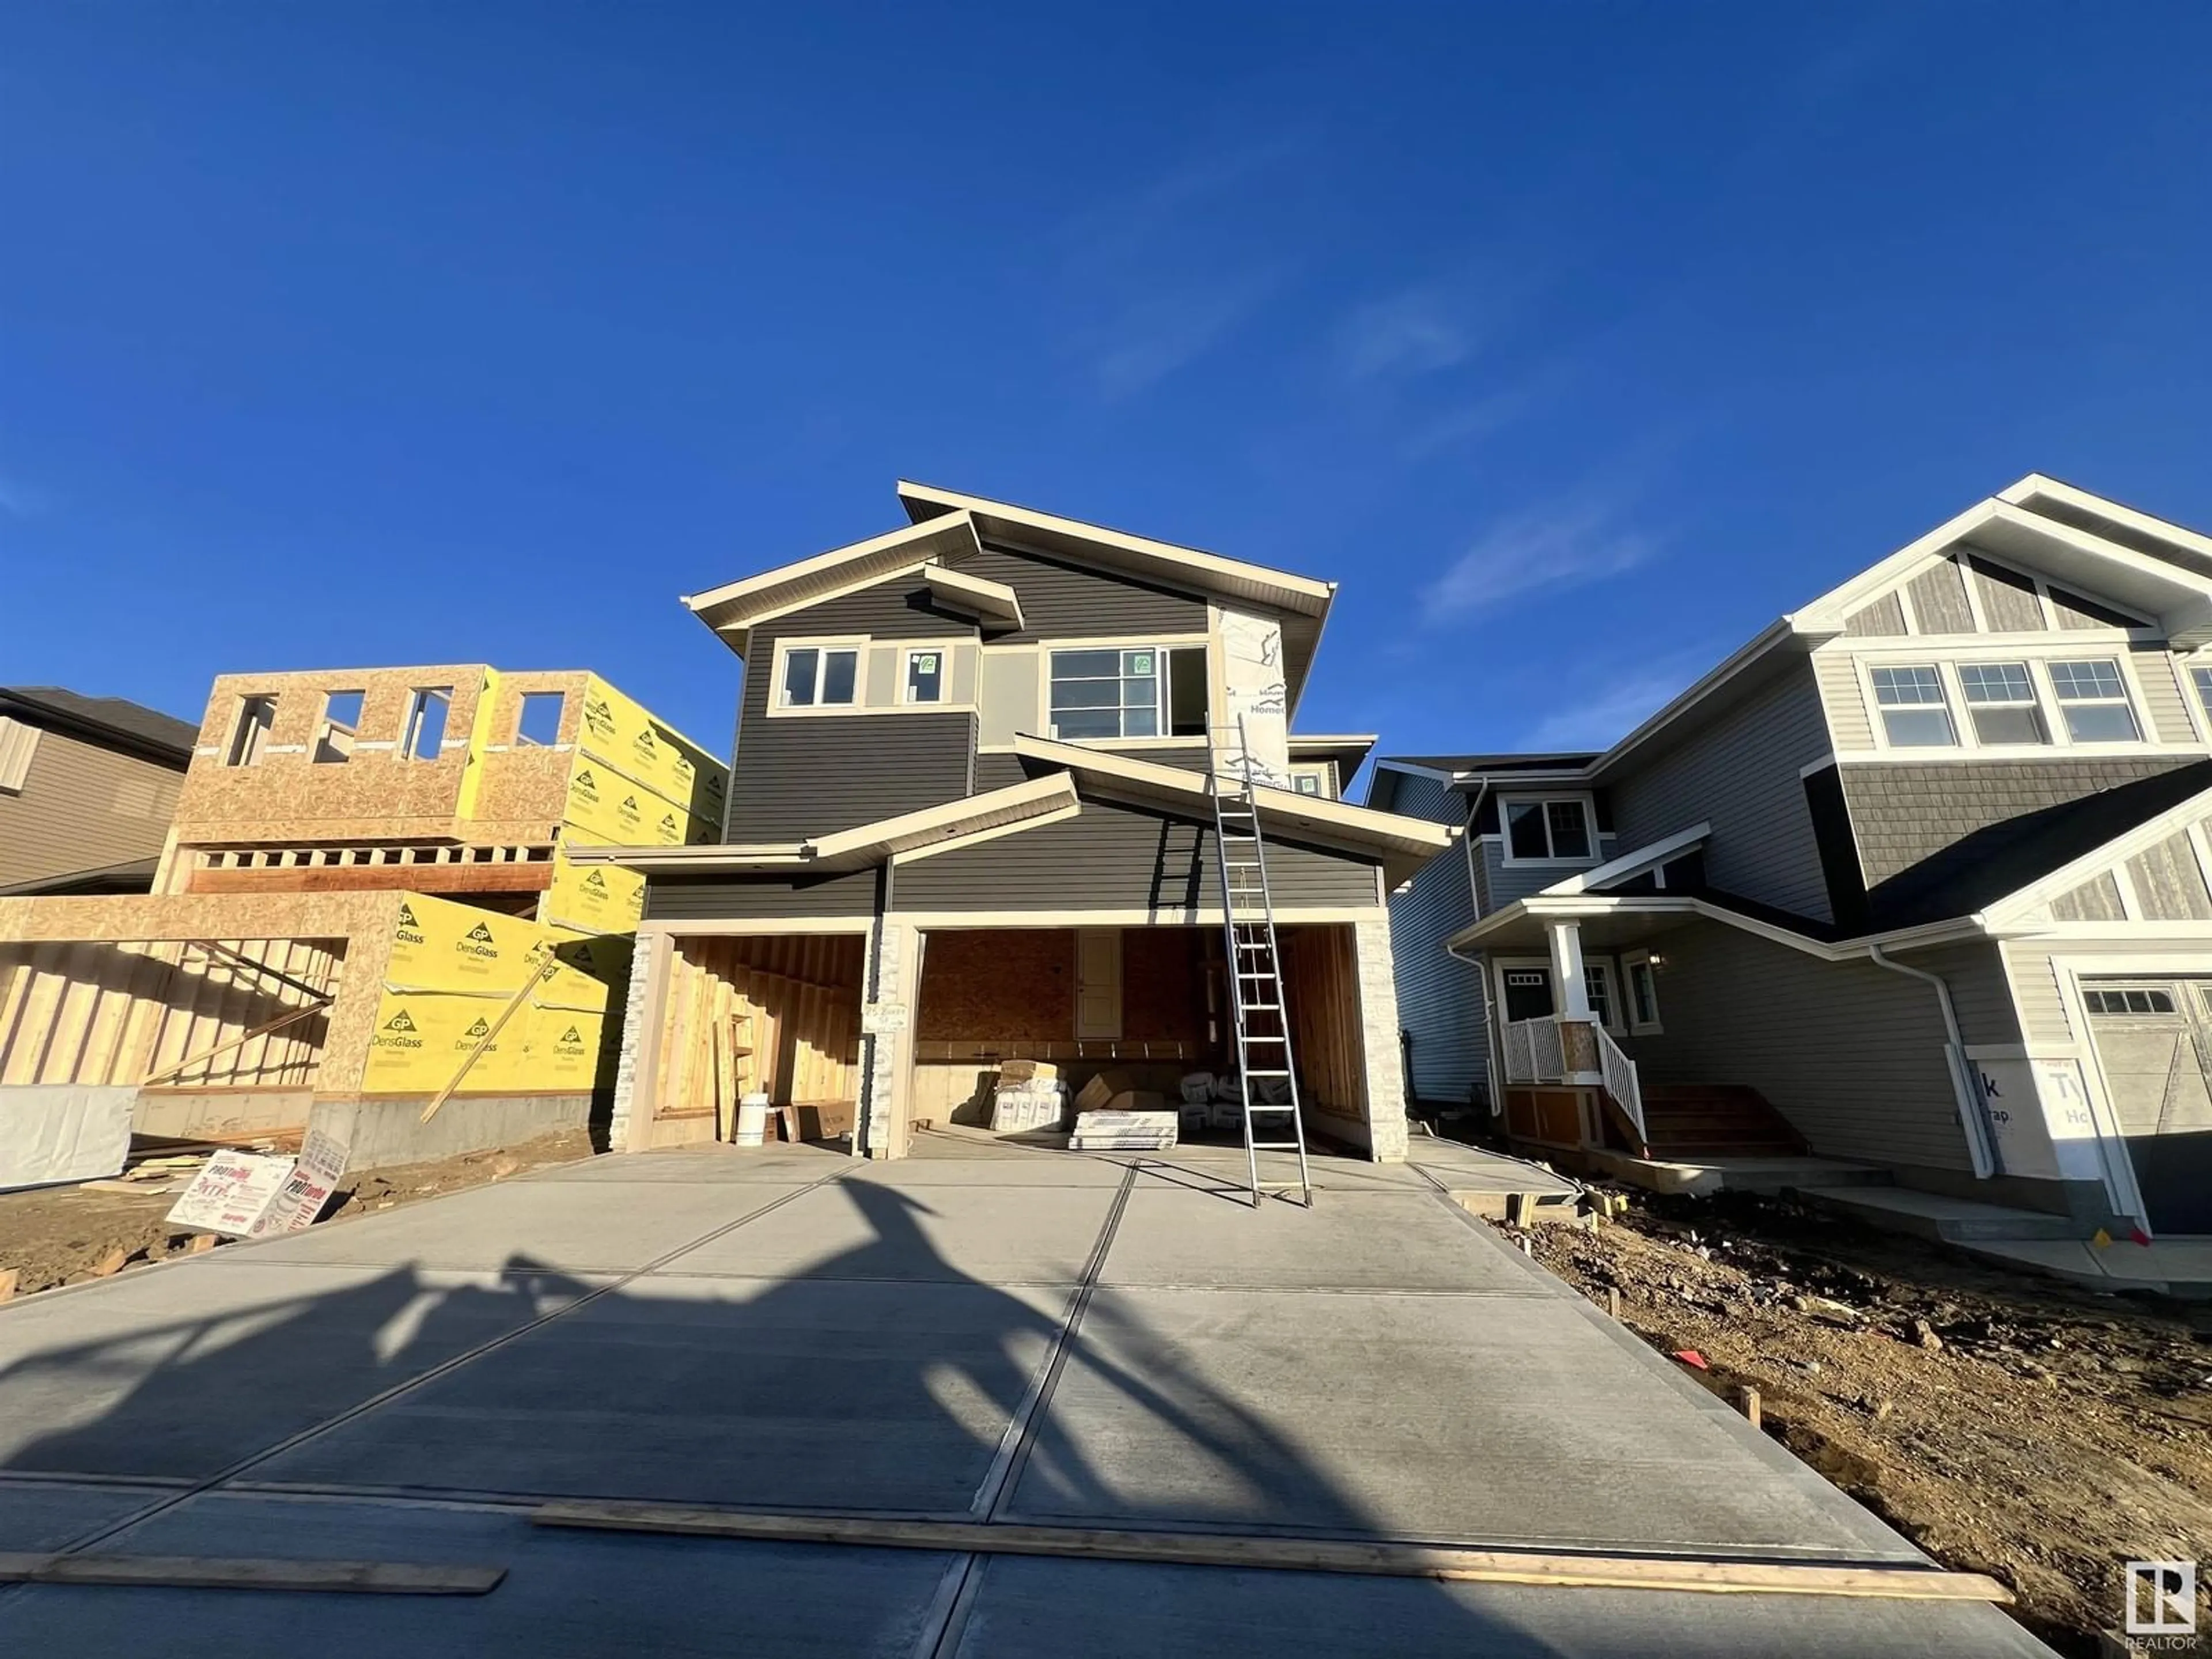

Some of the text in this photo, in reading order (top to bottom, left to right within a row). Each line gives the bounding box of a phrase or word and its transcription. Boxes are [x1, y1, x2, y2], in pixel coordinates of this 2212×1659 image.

[472, 929, 488, 940] GP
[456, 941, 498, 959] DensGlass
[391, 1018, 410, 1029] GP
[471, 1025, 488, 1035] GP
[372, 1035, 422, 1048] DensGlass
